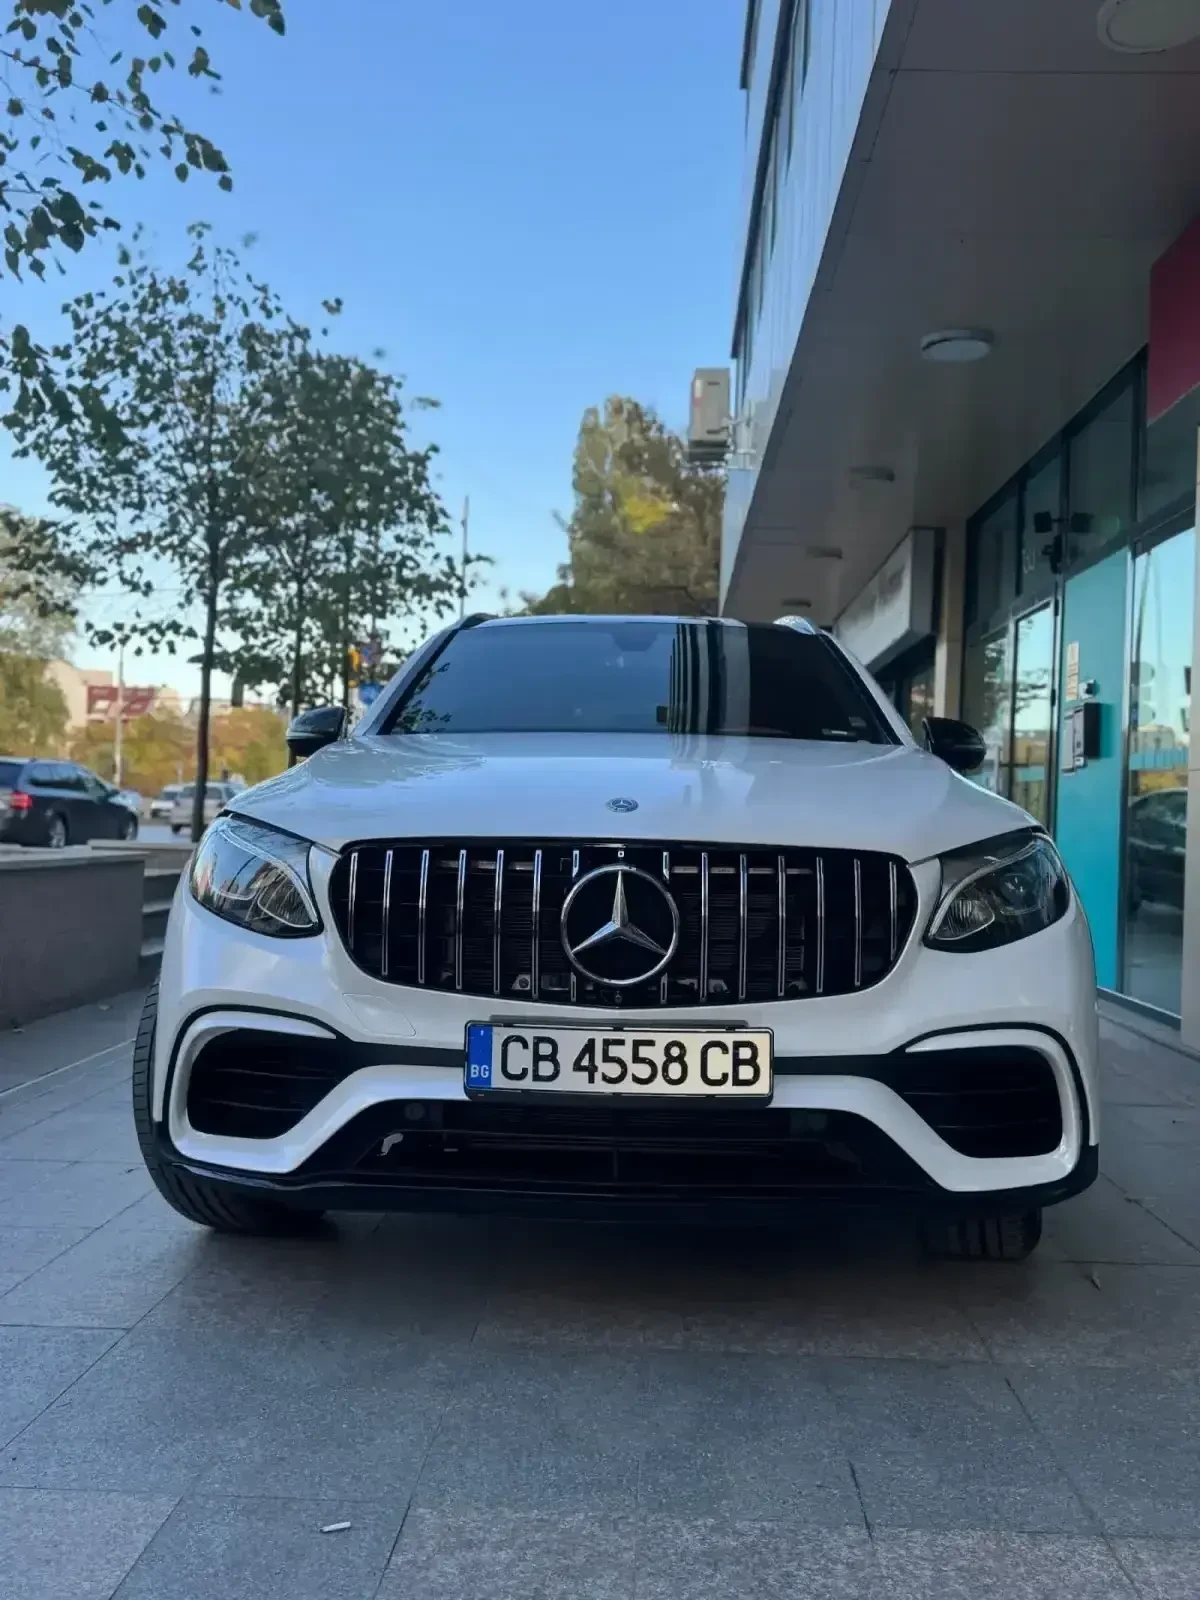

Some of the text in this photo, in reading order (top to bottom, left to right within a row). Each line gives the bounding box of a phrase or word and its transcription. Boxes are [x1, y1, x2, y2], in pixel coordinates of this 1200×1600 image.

[470, 1064, 489, 1078] BG
[501, 1035, 760, 1087] CB 4558 CB
